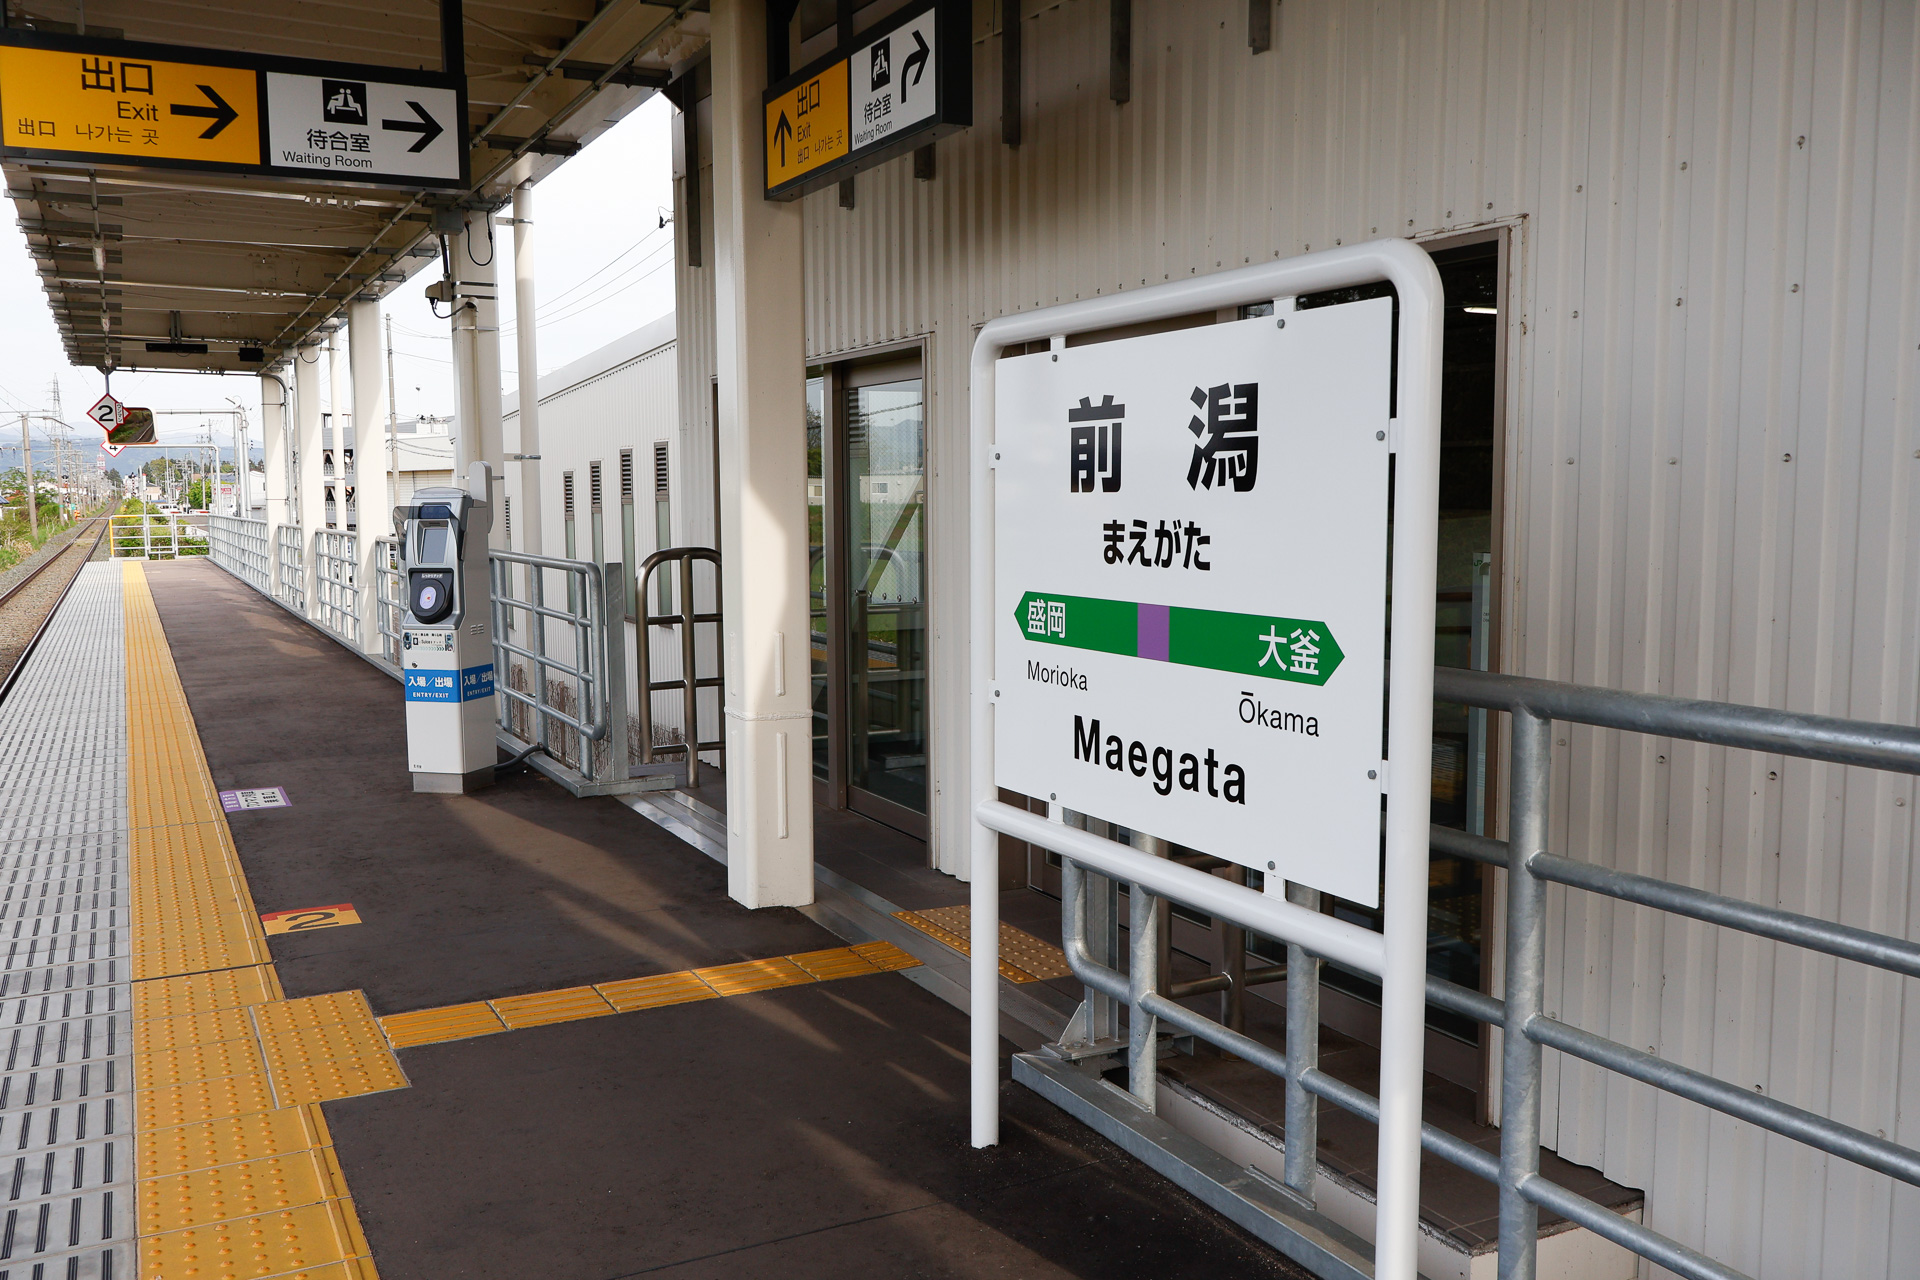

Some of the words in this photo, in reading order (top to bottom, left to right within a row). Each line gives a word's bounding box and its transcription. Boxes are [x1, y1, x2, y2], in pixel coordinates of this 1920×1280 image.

[81, 57, 154, 95] 出口
[117, 101, 159, 122] Exit
[798, 80, 820, 118] 出口
[864, 94, 891, 125] 待合室
[18, 118, 56, 137] 出口
[75, 124, 133, 143] 나가는
[141, 128, 159, 145] 곳
[306, 128, 371, 153] 待合室
[798, 122, 810, 142] Exit
[854, 130, 874, 145] Waiting
[876, 120, 892, 136] Room
[282, 151, 331, 168] Waiting
[335, 155, 373, 169] Room
[798, 146, 809, 164] 出口
[814, 134, 834, 154] 나가는
[98, 405, 114, 421] 2
[1103, 519, 1211, 571] まえがた
[1027, 599, 1067, 639] 盛岡
[1257, 625, 1321, 676] 大釜
[408, 676, 453, 688] 入場／出場
[1027, 659, 1089, 692] Morioka
[412, 691, 449, 699] ENTRY/EXIT
[1238, 690, 1320, 738] Ōkama
[1073, 714, 1246, 806] Maegata
[284, 911, 340, 931] 2
